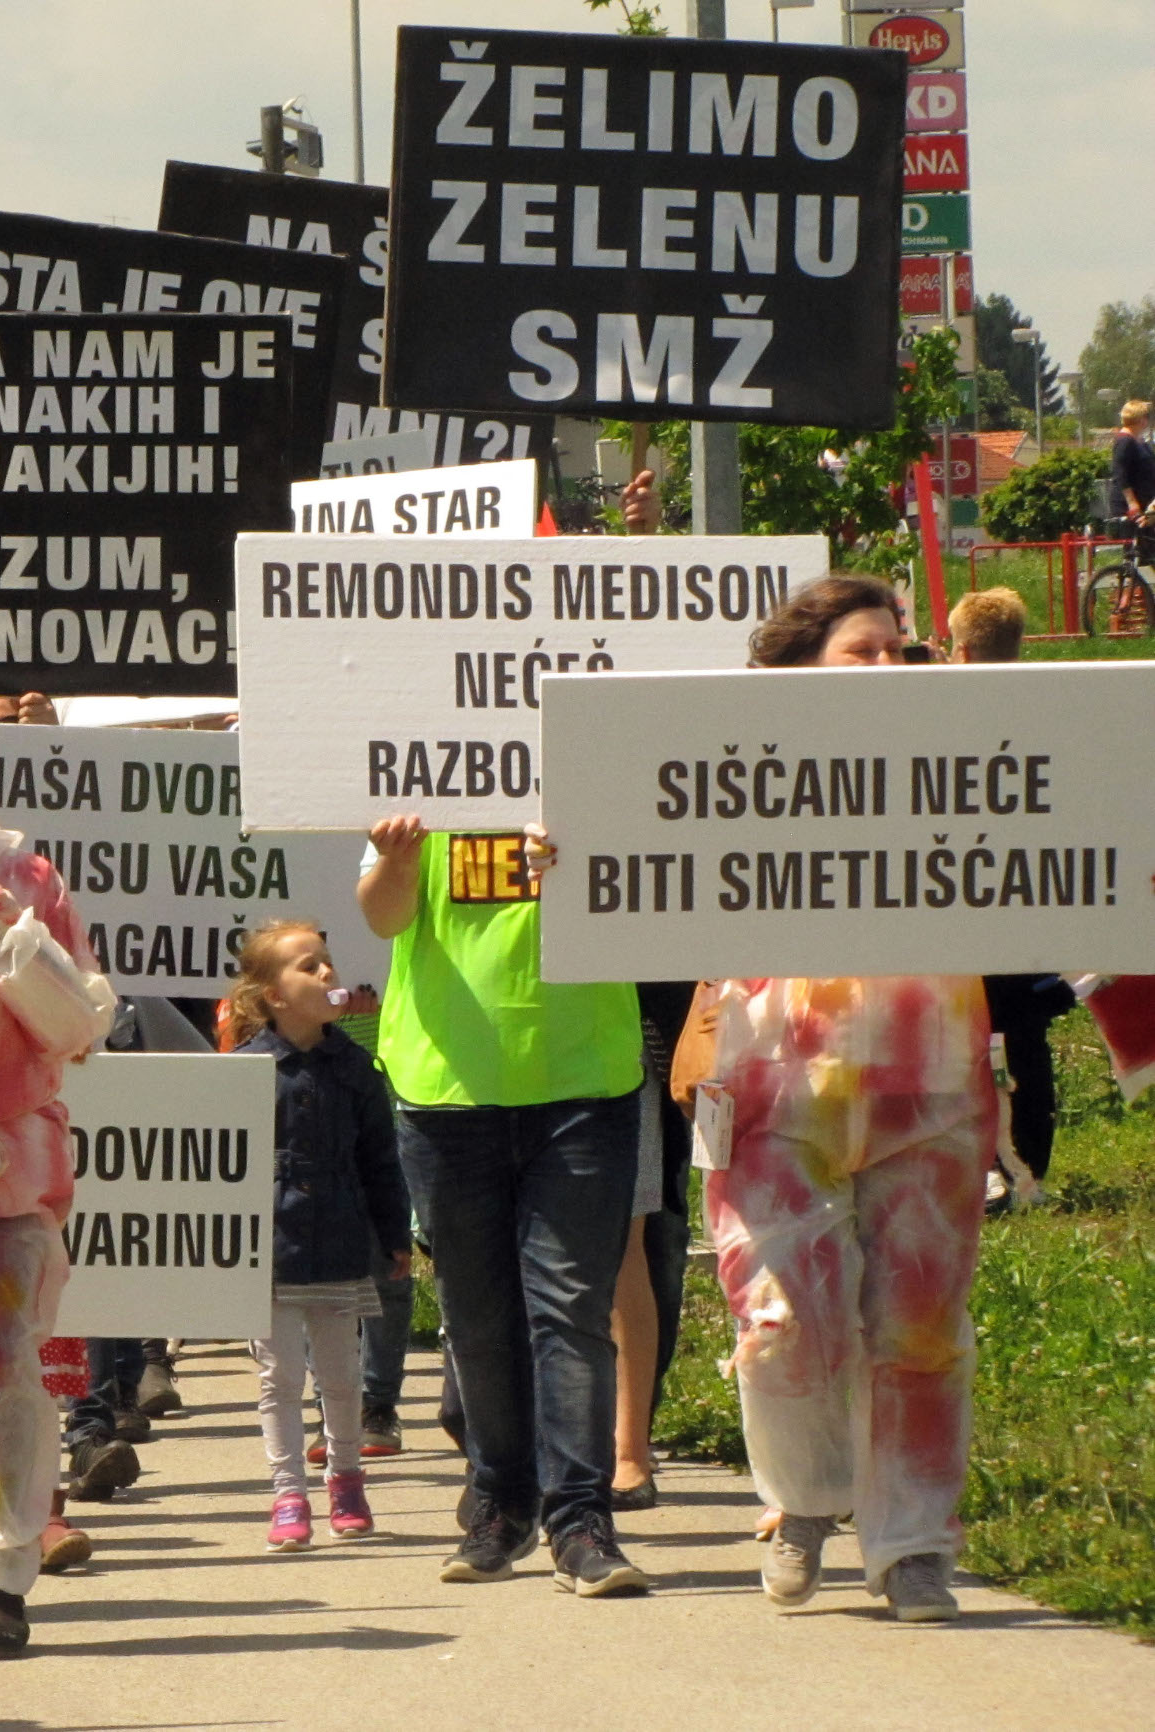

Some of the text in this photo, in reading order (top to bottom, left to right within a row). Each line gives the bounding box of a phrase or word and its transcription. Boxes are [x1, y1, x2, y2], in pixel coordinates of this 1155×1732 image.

[877, 29, 942, 55] Hervis
[437, 40, 858, 161] ŽELIMO
[427, 180, 859, 278] ZELENU
[33, 331, 173, 378] NAM
[201, 331, 275, 378] JE
[509, 293, 773, 408] SMŽ
[204, 387, 219, 433] I
[393, 486, 501, 534] STAR
[262, 560, 788, 622] REMONDIS MEDISON
[368, 741, 540, 798] RAZBO
[656, 740, 1052, 821] SIŠČANI NEĆE
[34, 834, 289, 900] NISU VAŠA
[588, 833, 1118, 914] BITI SMETLIŠĆANI!
[61, 1212, 260, 1268] VARINU!
